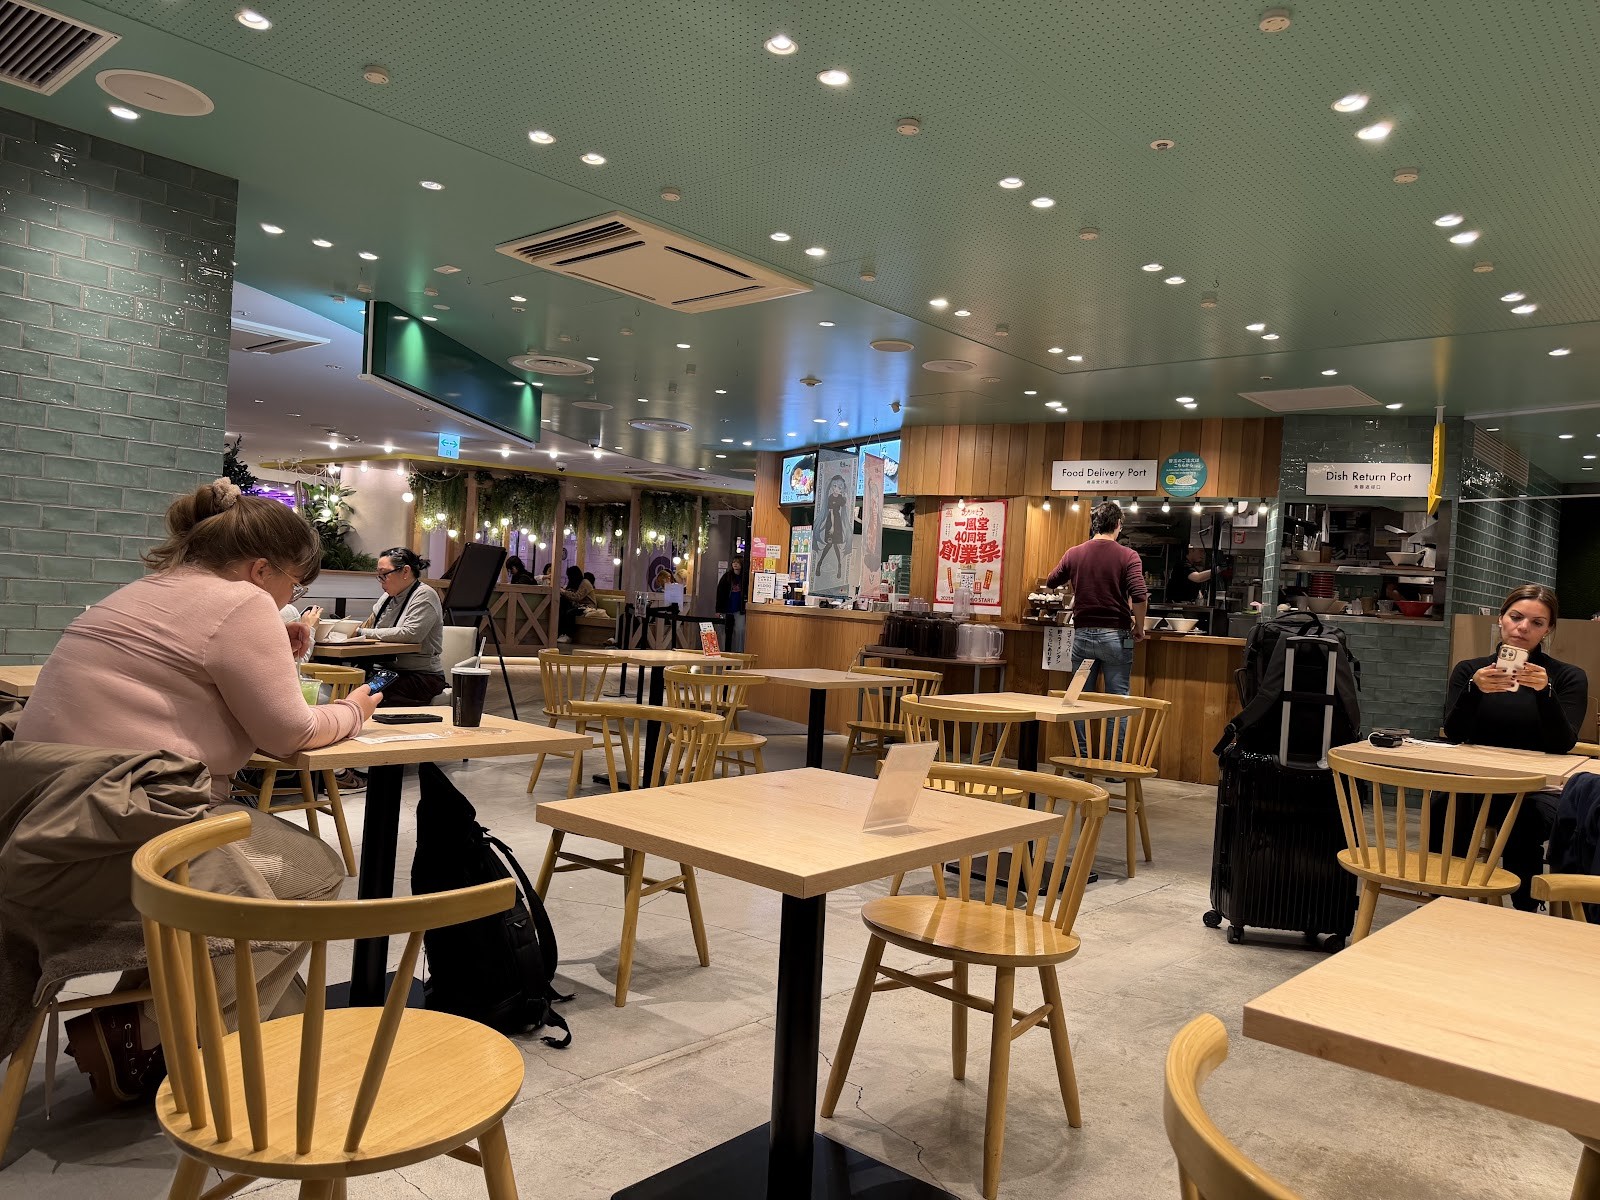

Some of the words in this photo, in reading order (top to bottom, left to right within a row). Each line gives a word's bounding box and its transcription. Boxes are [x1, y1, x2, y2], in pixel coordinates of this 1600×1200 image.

[1062, 467, 1084, 477] Food
[1087, 468, 1125, 479] Delivery
[1127, 468, 1147, 477] Port
[1326, 471, 1348, 481] Dish
[1352, 471, 1386, 482] Return
[1390, 472, 1412, 482] Port
[954, 516, 990, 531] 一風堂
[954, 530, 987, 543] 40周年
[939, 539, 1001, 564] 創業祭
